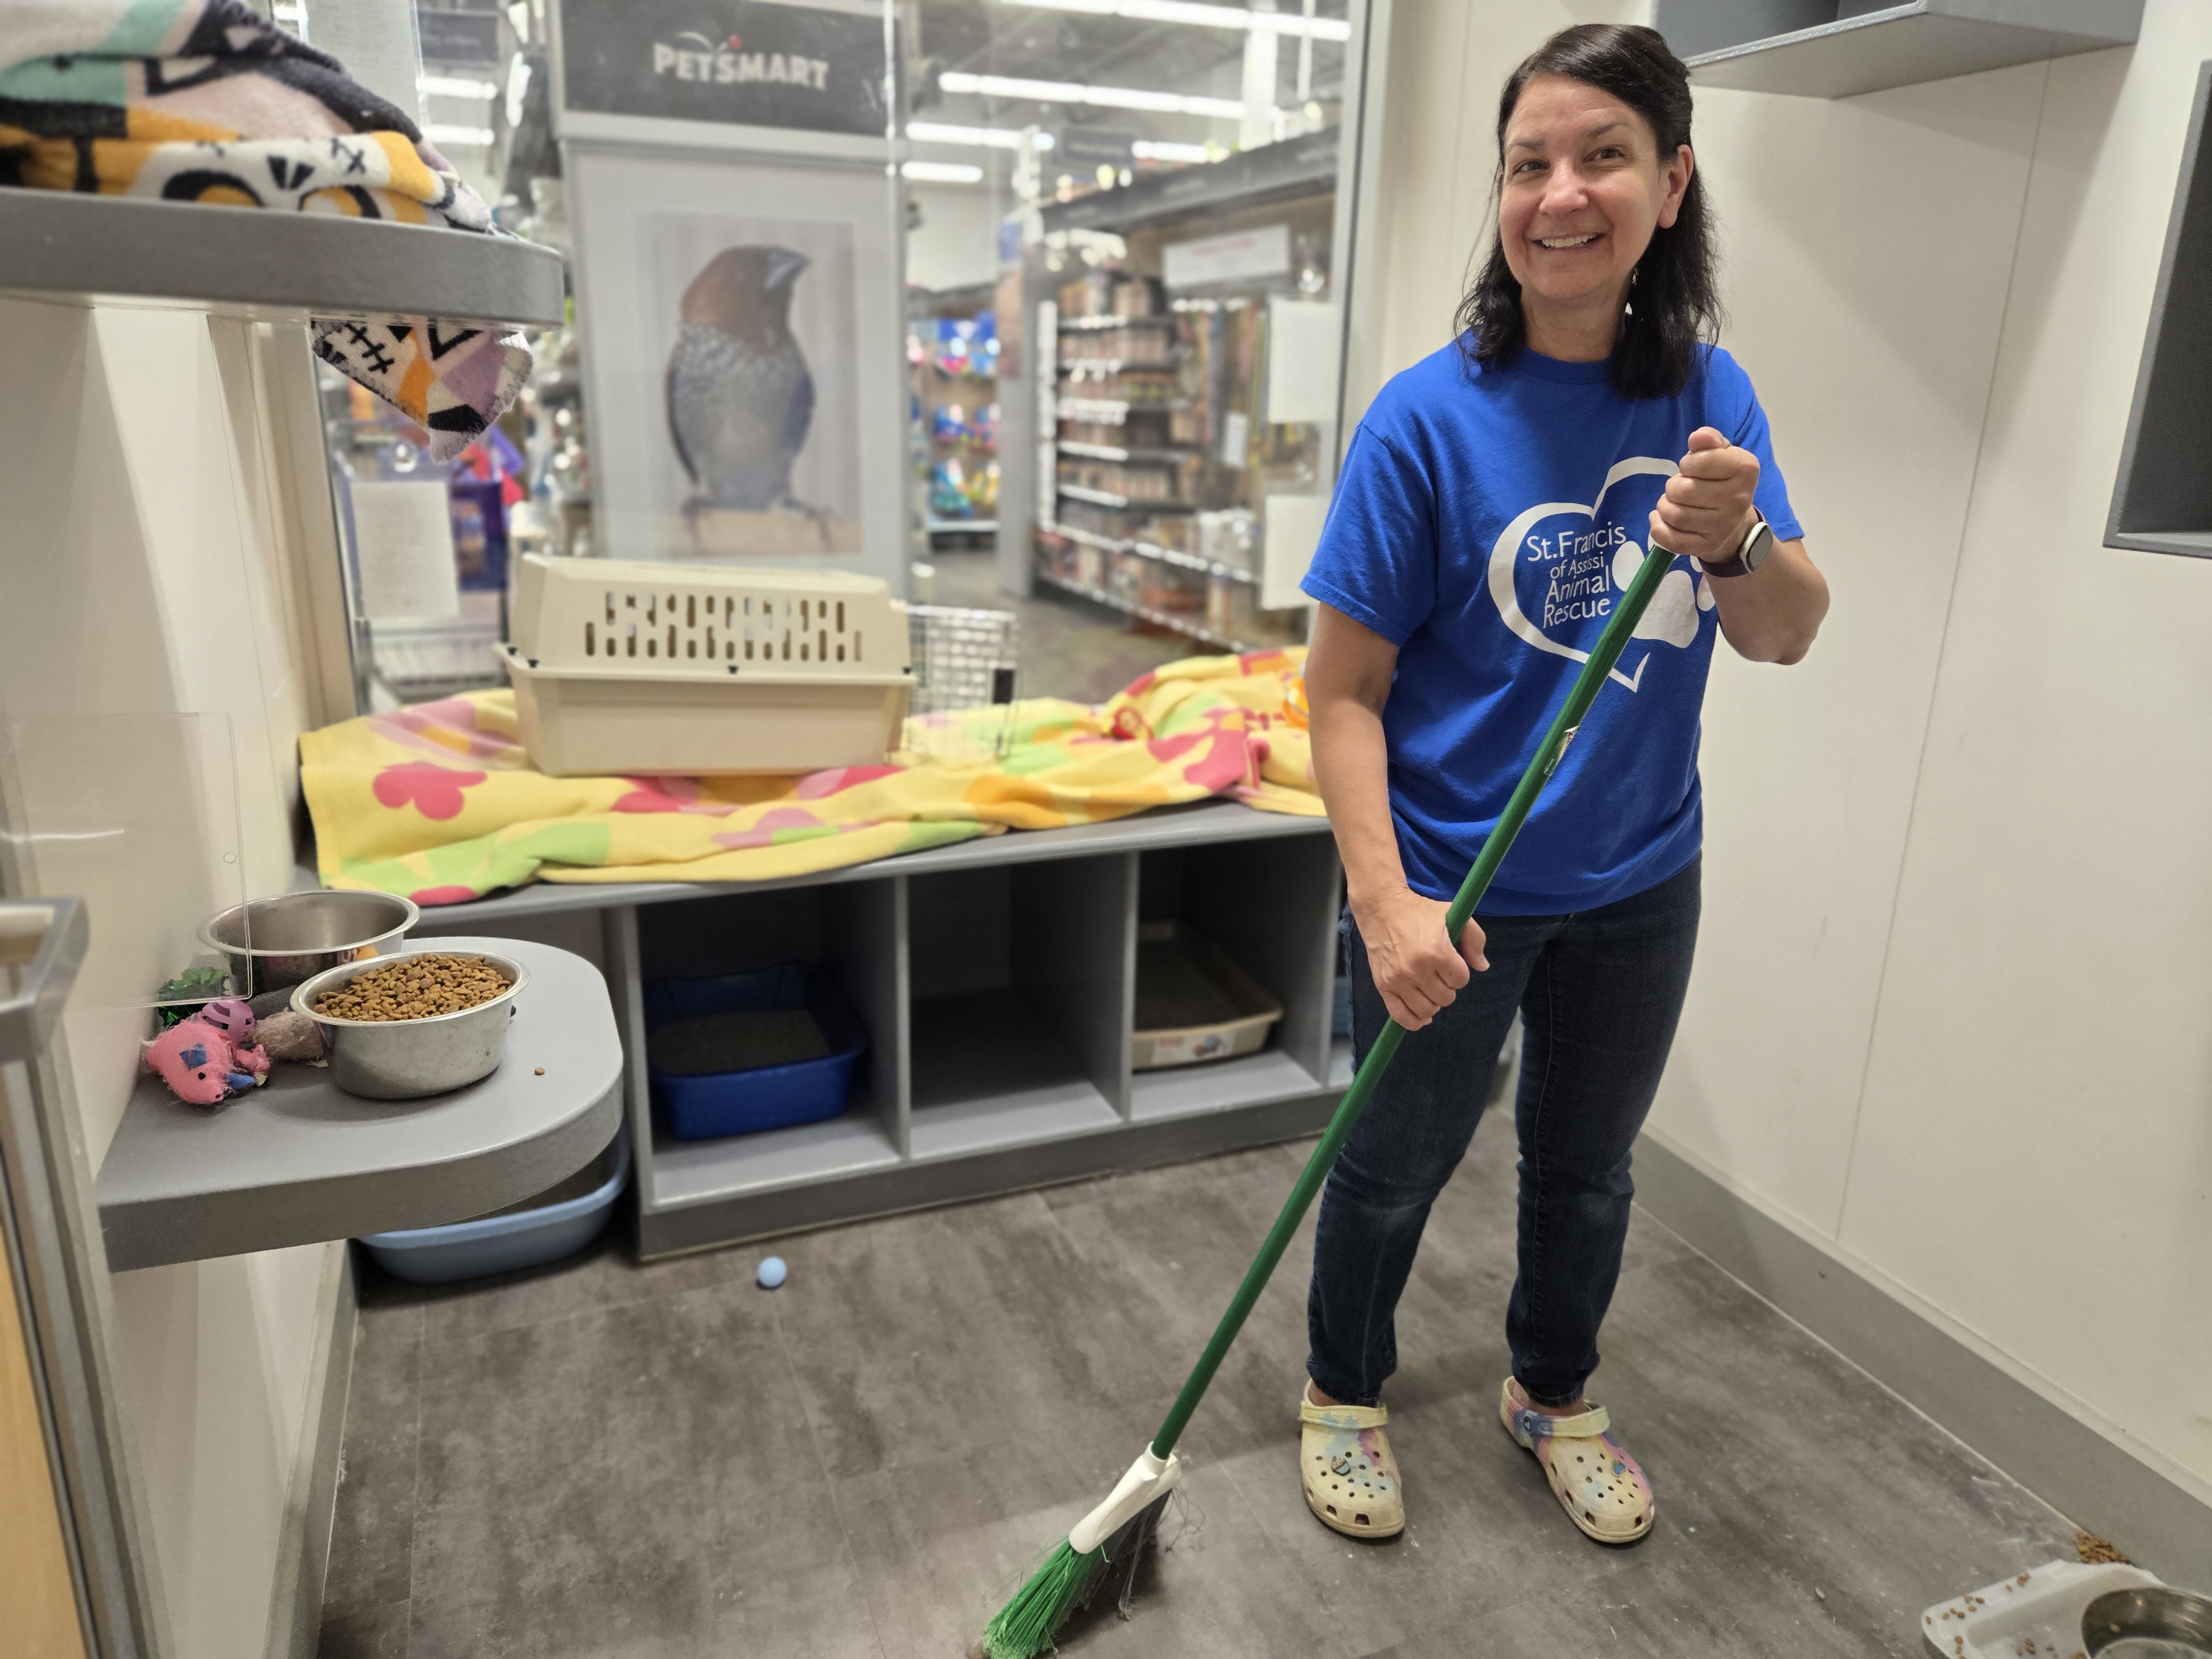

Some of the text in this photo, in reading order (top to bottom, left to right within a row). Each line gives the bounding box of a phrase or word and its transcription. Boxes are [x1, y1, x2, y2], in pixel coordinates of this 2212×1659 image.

[653, 41, 828, 90] PETSMART
[1558, 521, 1627, 557] Francis
[1545, 565, 1610, 604] Animal
[1550, 559, 1568, 579] of
[1543, 598, 1610, 629] Rescue
